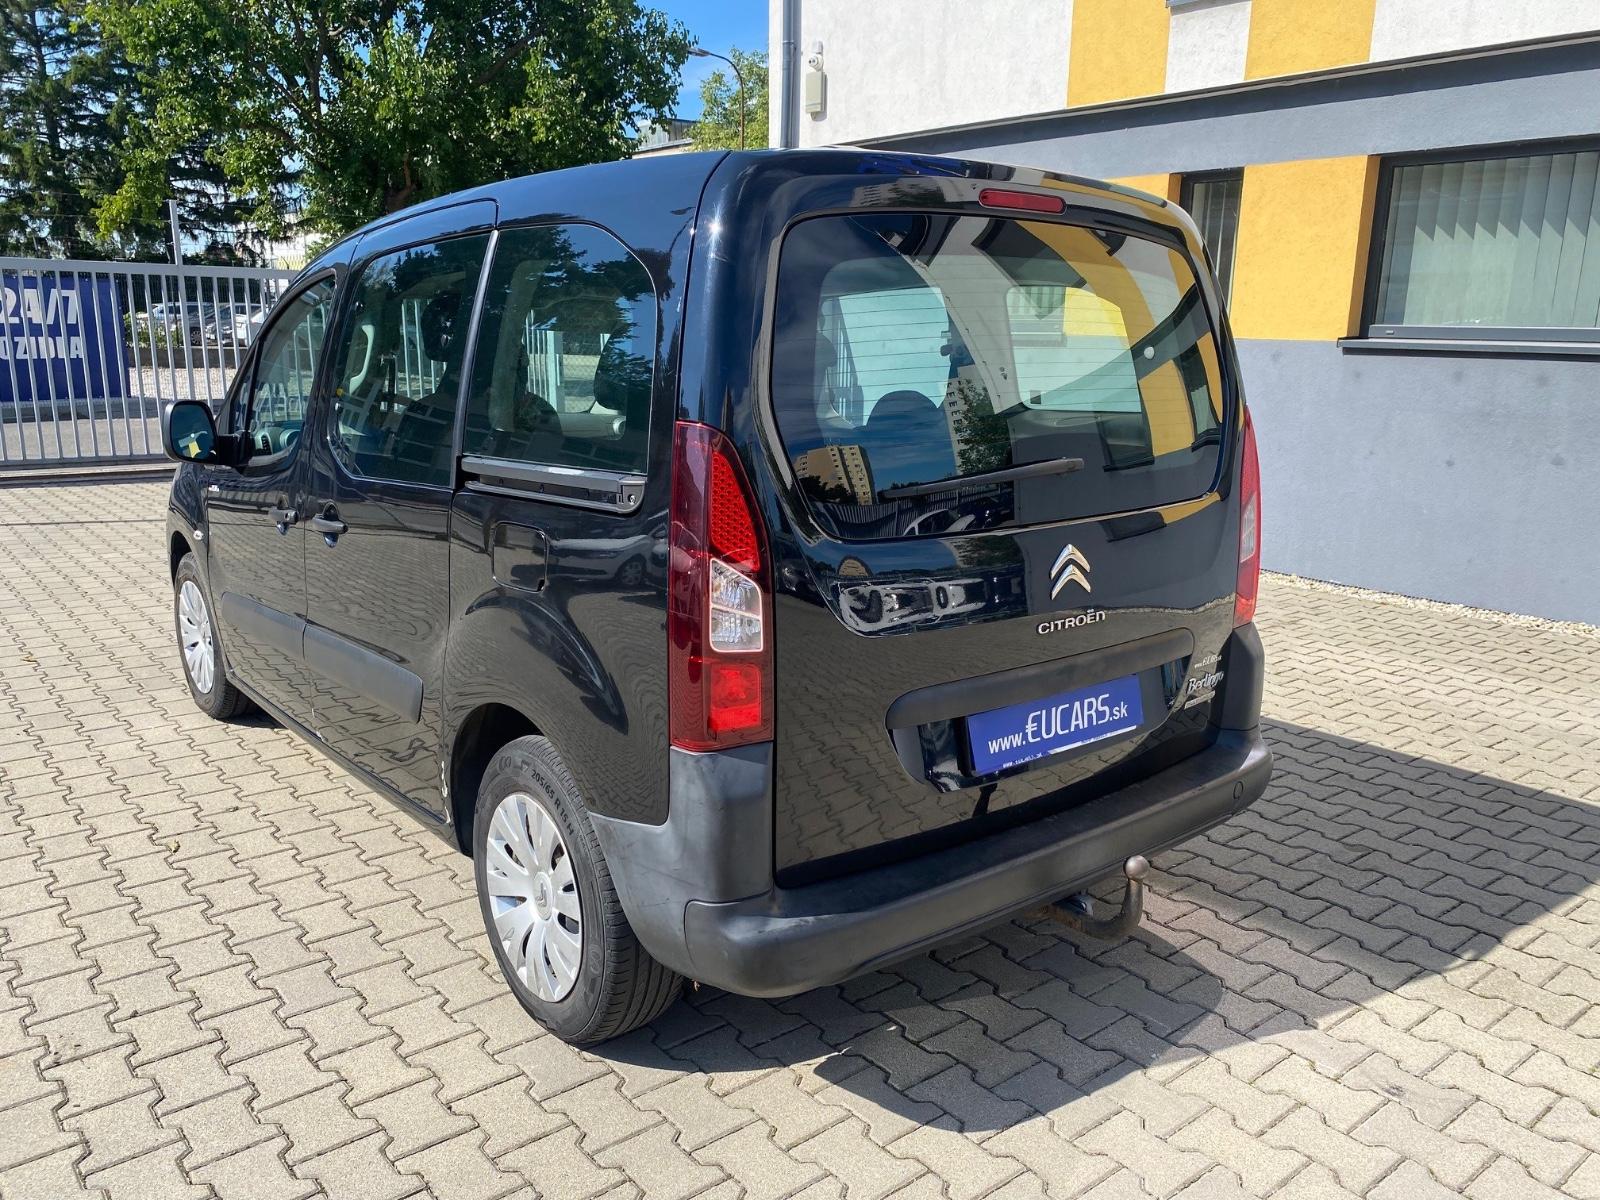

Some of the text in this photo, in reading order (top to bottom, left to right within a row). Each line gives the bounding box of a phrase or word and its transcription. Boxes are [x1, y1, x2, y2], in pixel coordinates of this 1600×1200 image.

[0, 287, 80, 324] 24/7
[1186, 670, 1225, 695] Berlingo
[530, 769, 555, 799] 205/65
[554, 797, 561, 810] R
[560, 808, 568, 823] 15
